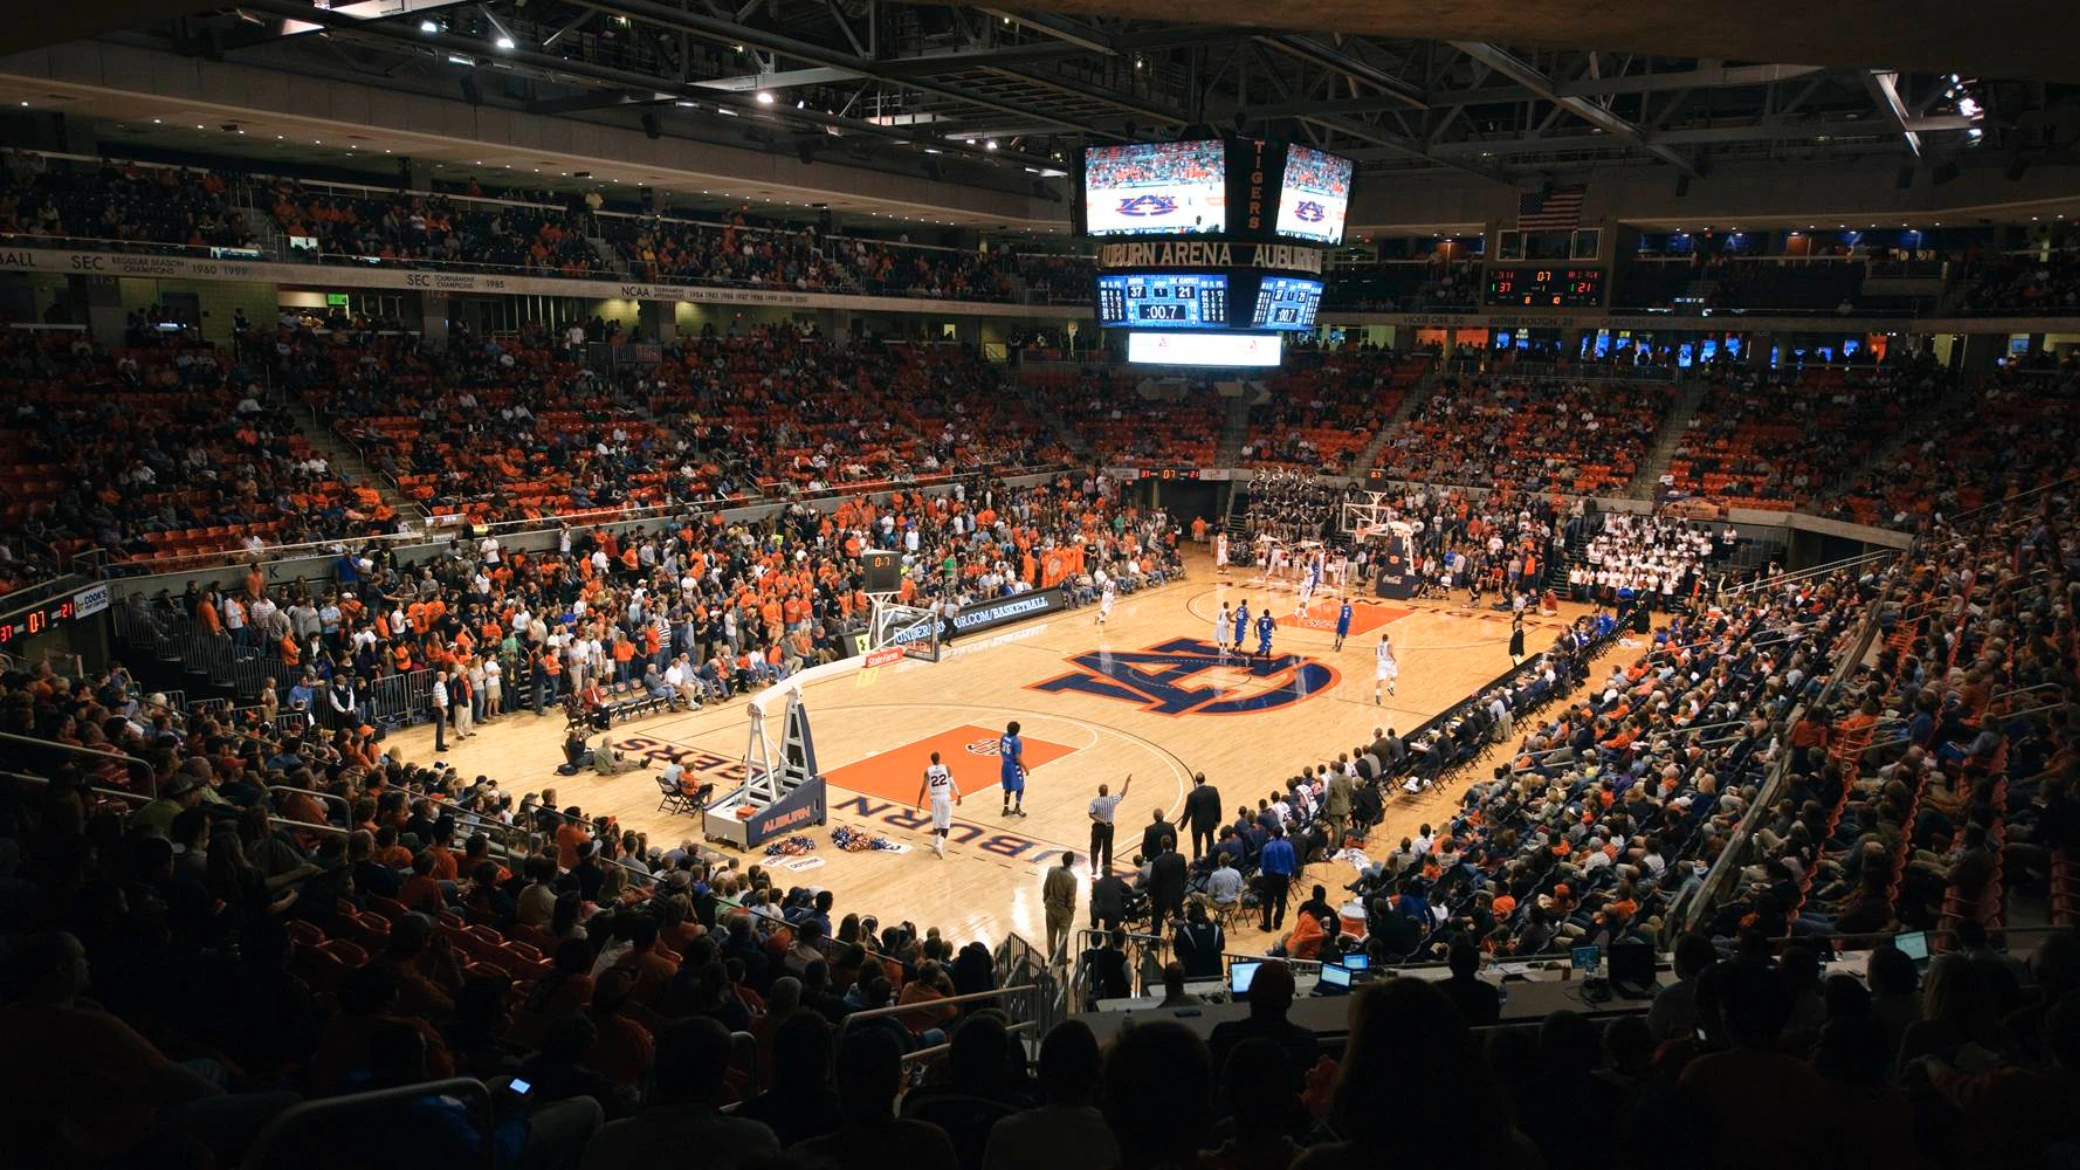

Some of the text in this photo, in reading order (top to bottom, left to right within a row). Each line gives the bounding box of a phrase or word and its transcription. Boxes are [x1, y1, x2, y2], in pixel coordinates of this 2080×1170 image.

[1248, 141, 1267, 230] TIGERS
[1160, 242, 1232, 266] ARENA
[71, 256, 104, 271] SEC
[124, 265, 174, 275] CHAMPIONS
[193, 264, 248, 276] 1960 1999
[407, 274, 430, 287] SEC
[486, 280, 504, 289] 1985
[1499, 282, 1511, 292] 37
[621, 286, 649, 298] NCAA
[1128, 287, 1143, 298] 37
[1178, 287, 1191, 298] 21
[1577, 282, 1592, 293] 21
[1146, 305, 1178, 319] :00.7
[60, 602, 74, 618] 21
[0, 625, 13, 643] 37
[930, 774, 947, 788] 22
[762, 804, 811, 834] AUBURN
